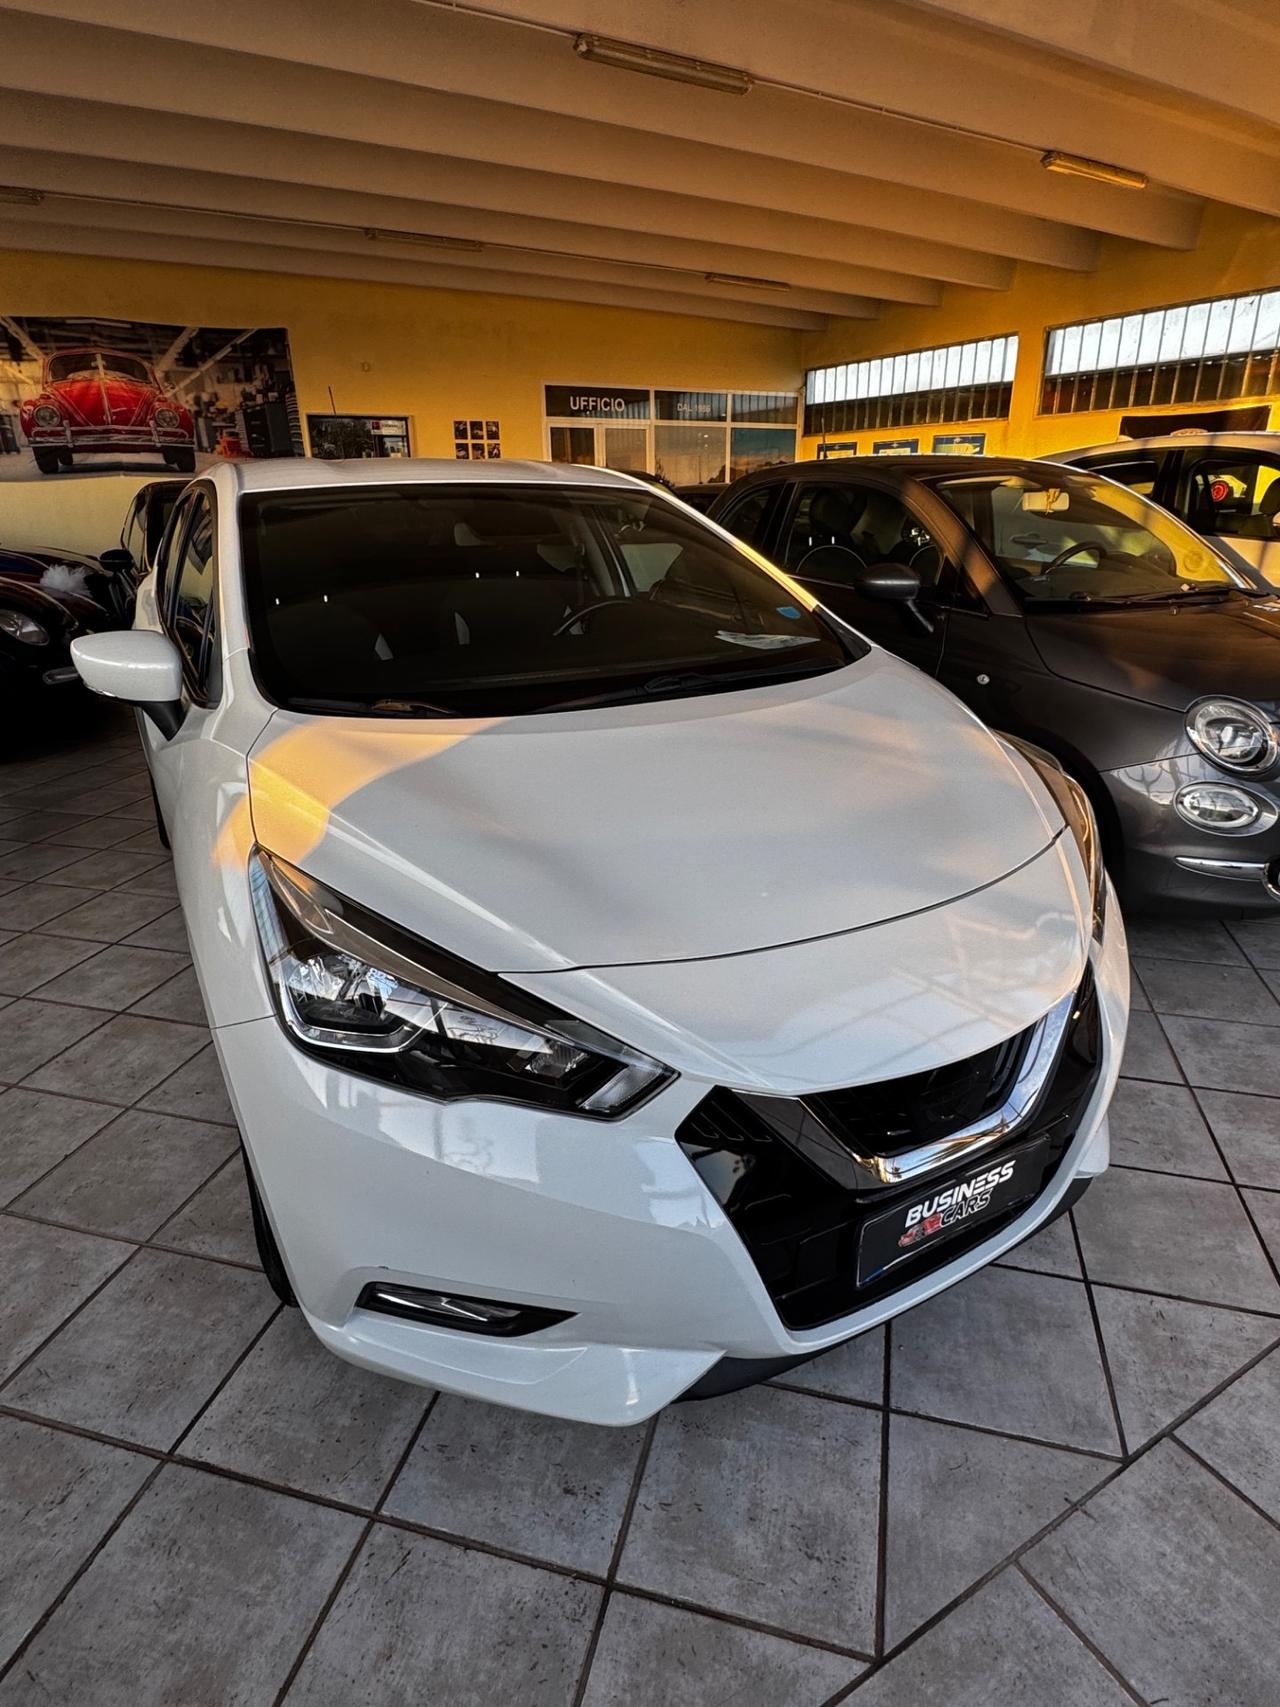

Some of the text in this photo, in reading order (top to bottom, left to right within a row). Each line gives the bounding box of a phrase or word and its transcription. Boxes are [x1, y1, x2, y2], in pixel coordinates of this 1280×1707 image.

[570, 396, 625, 412] UFFICIO
[905, 1160, 1016, 1228] BUSINESS
[940, 1188, 994, 1227] CARS
